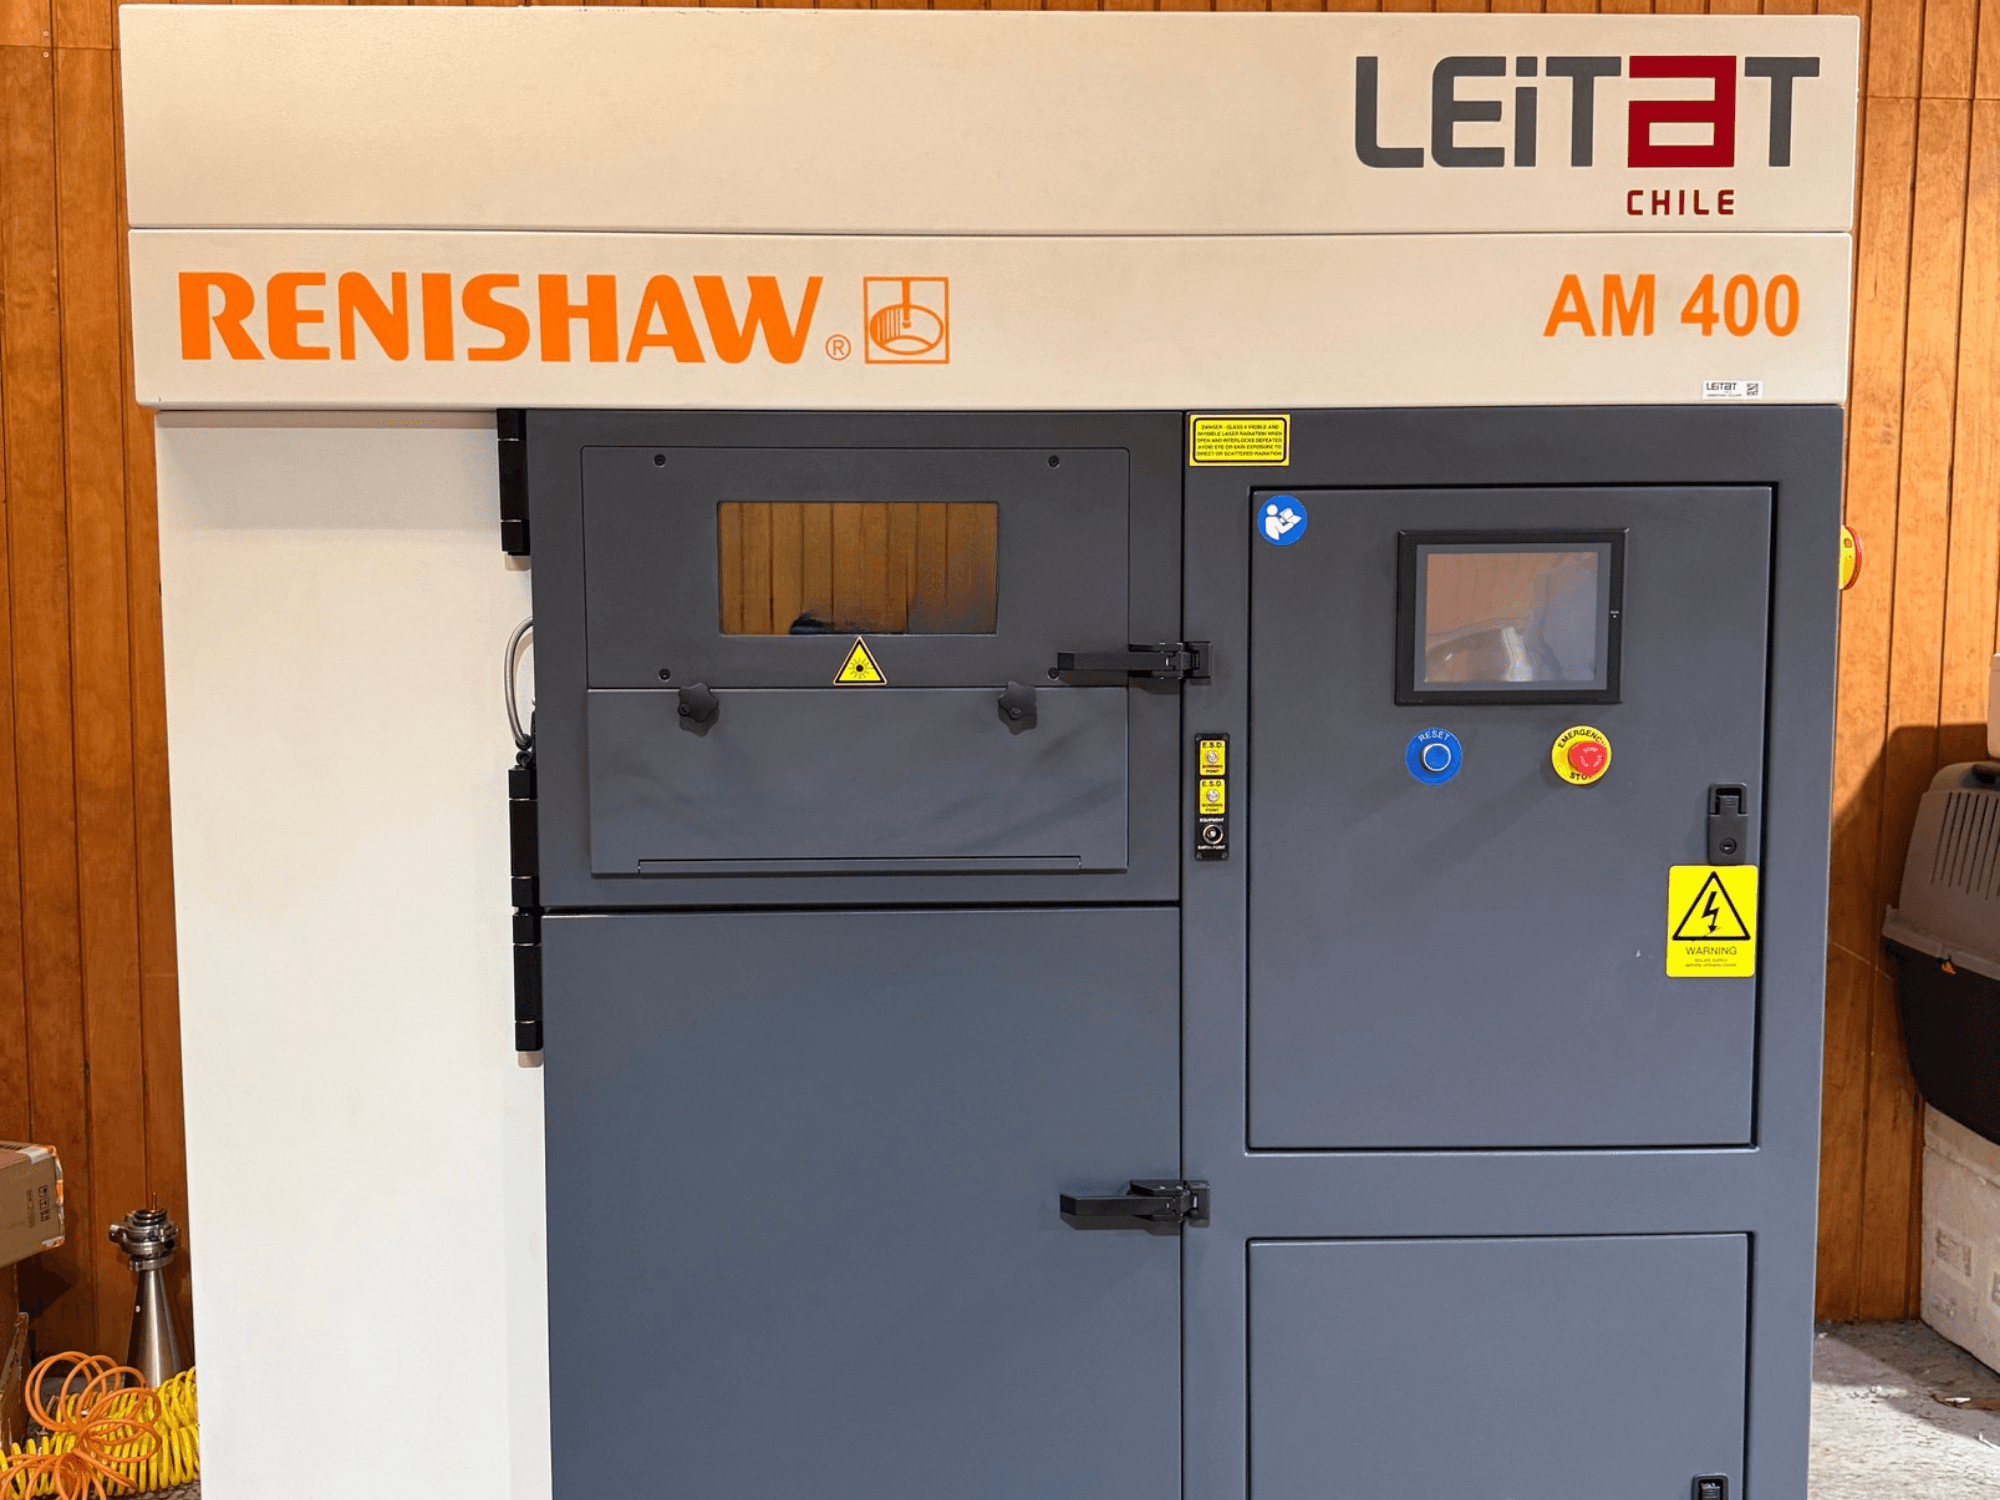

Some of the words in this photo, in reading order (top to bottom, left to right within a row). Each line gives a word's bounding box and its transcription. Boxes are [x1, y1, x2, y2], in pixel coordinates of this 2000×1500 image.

[1627, 189, 1735, 216] CHILE
[1543, 273, 1655, 337] AM
[1680, 273, 1800, 337] 400
[178, 272, 823, 365] RENISHAW
[1418, 729, 1451, 742] RESET
[1558, 729, 1606, 748] EMERGENC
[1685, 946, 1737, 955] WARNING
